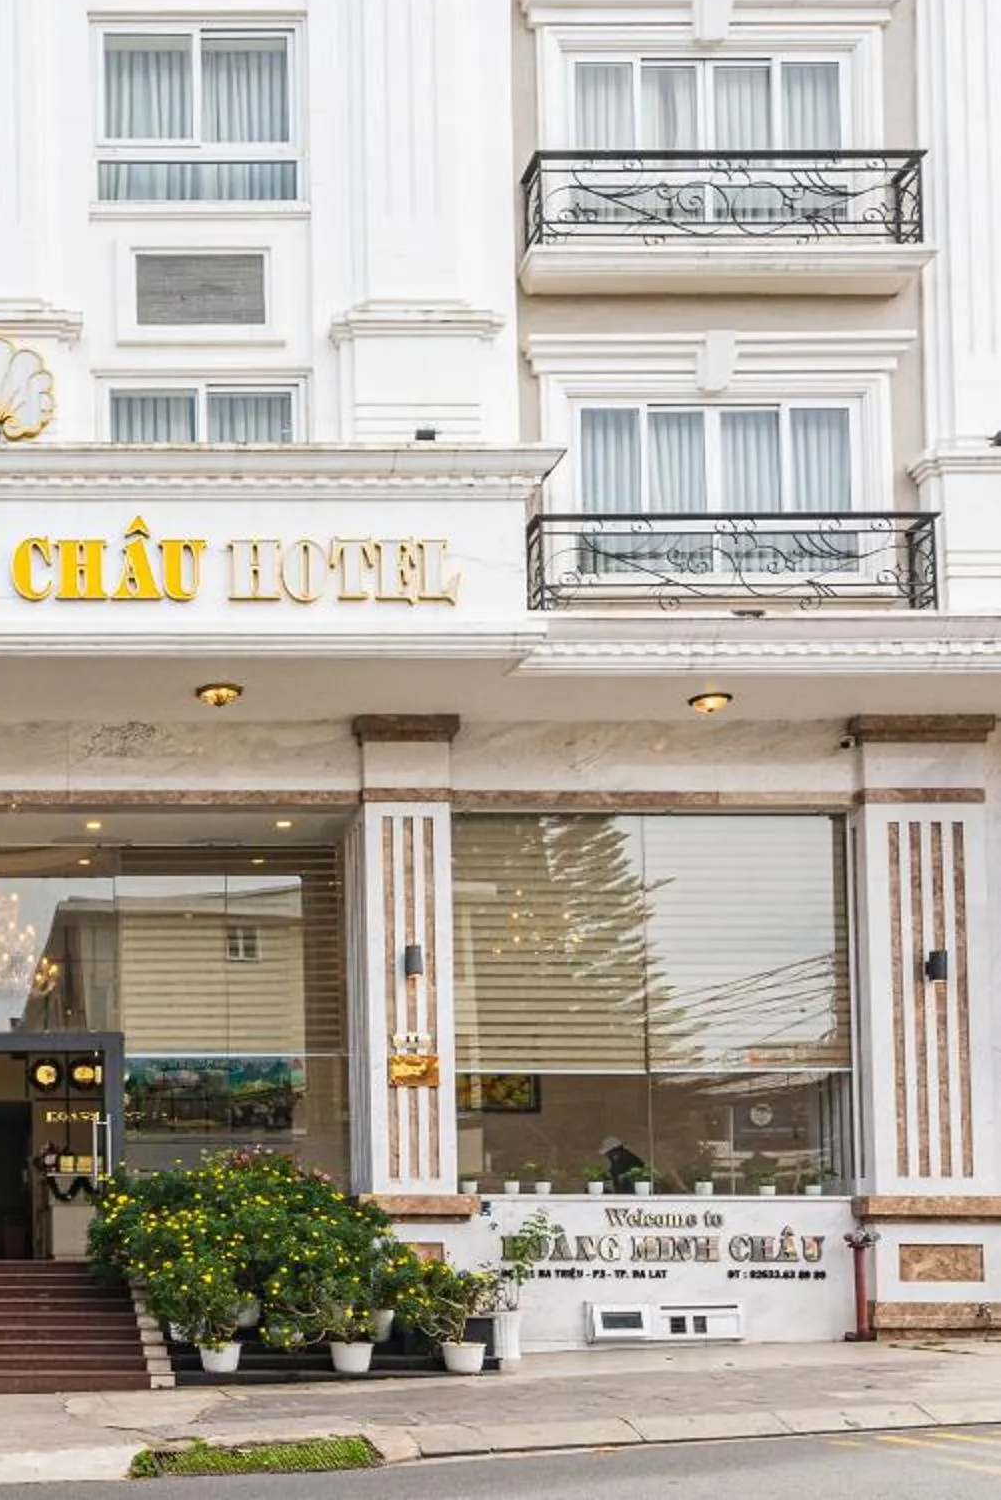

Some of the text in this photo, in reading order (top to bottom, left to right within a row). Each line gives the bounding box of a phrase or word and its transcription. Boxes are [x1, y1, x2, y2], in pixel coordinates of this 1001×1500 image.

[10, 515, 207, 602] CHÂU
[225, 534, 463, 606] HOTEL
[604, 1207, 724, 1229] Welcome to
[630, 1235, 720, 1262] MINH
[728, 1225, 826, 1262] CHÂU
